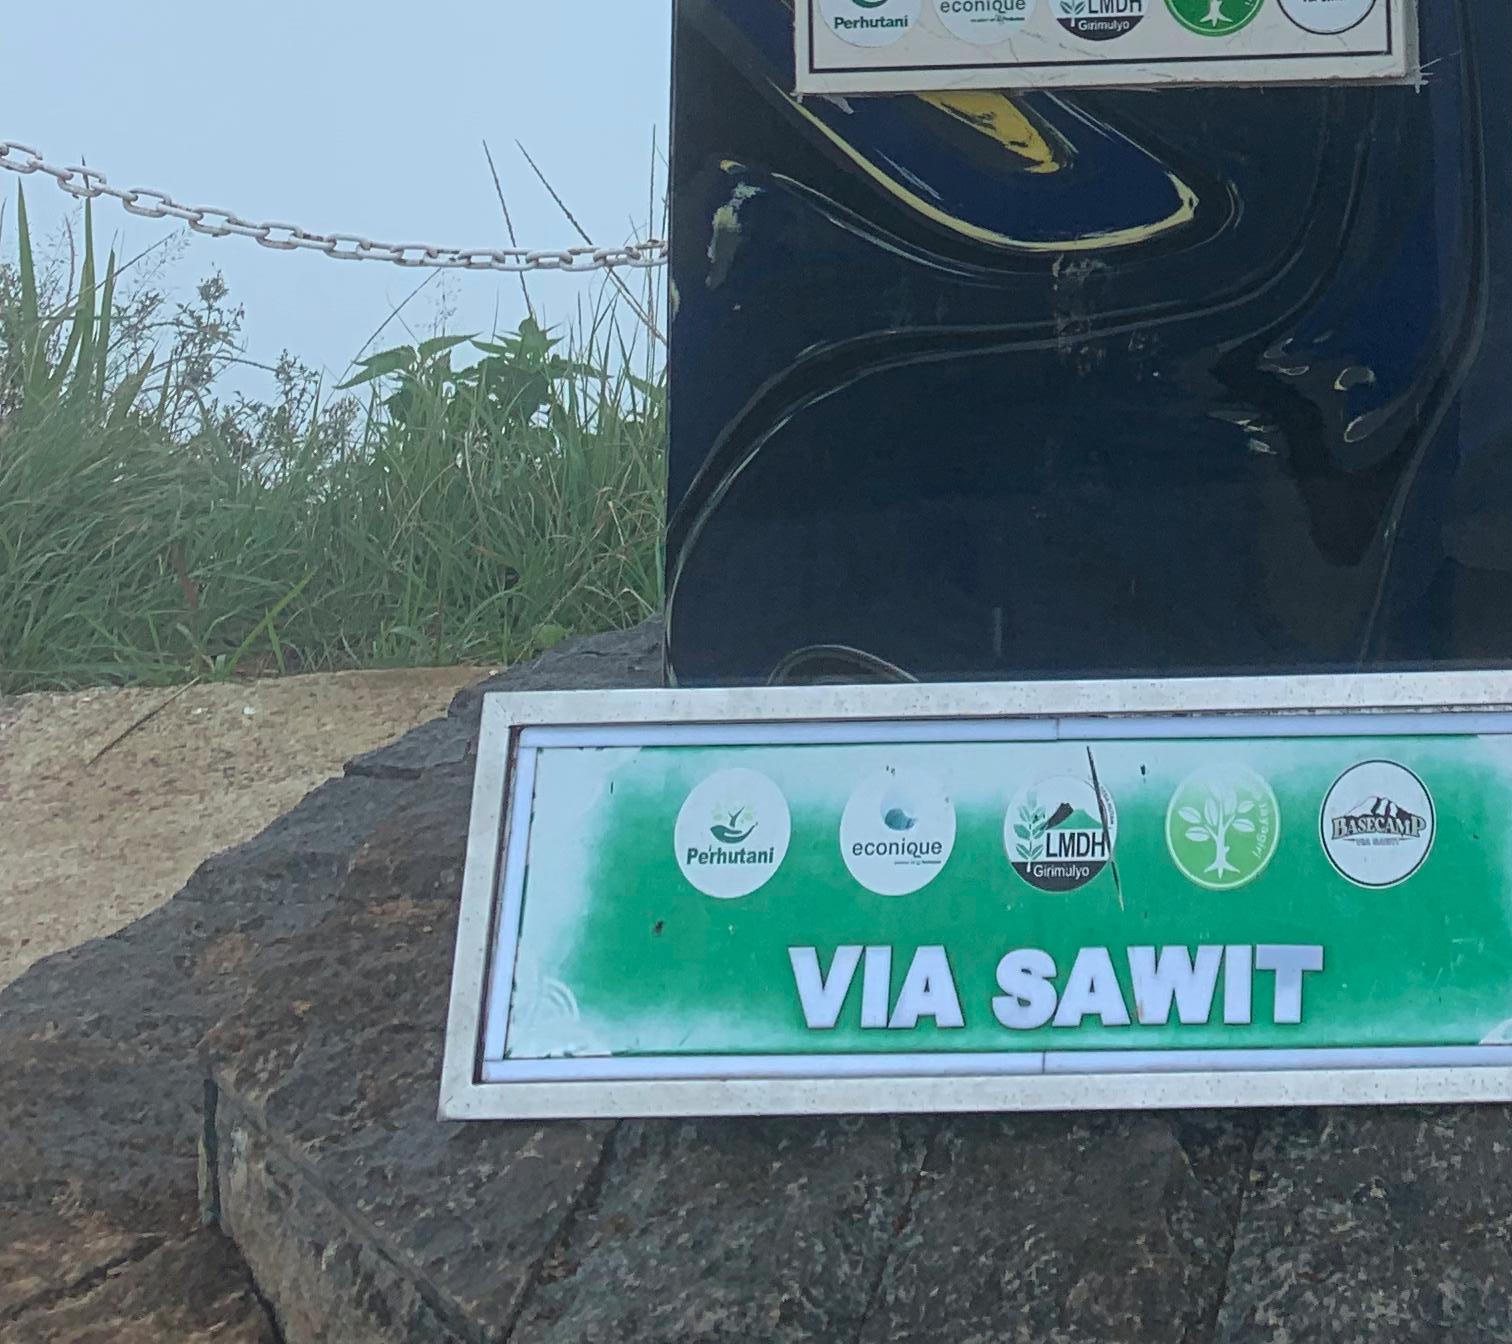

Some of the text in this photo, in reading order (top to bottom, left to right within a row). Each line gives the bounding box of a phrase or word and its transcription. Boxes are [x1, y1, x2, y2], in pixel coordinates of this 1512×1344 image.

[834, 15, 909, 30] Perhutani
[1078, 19, 1131, 32] Girimulyo
[1331, 813, 1427, 840] BASECAMP
[686, 845, 775, 865] Perhutani
[852, 838, 943, 859] econique
[1046, 832, 1106, 858] LMDH
[1033, 864, 1090, 880] Girimulyo
[787, 944, 1324, 1031] VIA SAWIT
